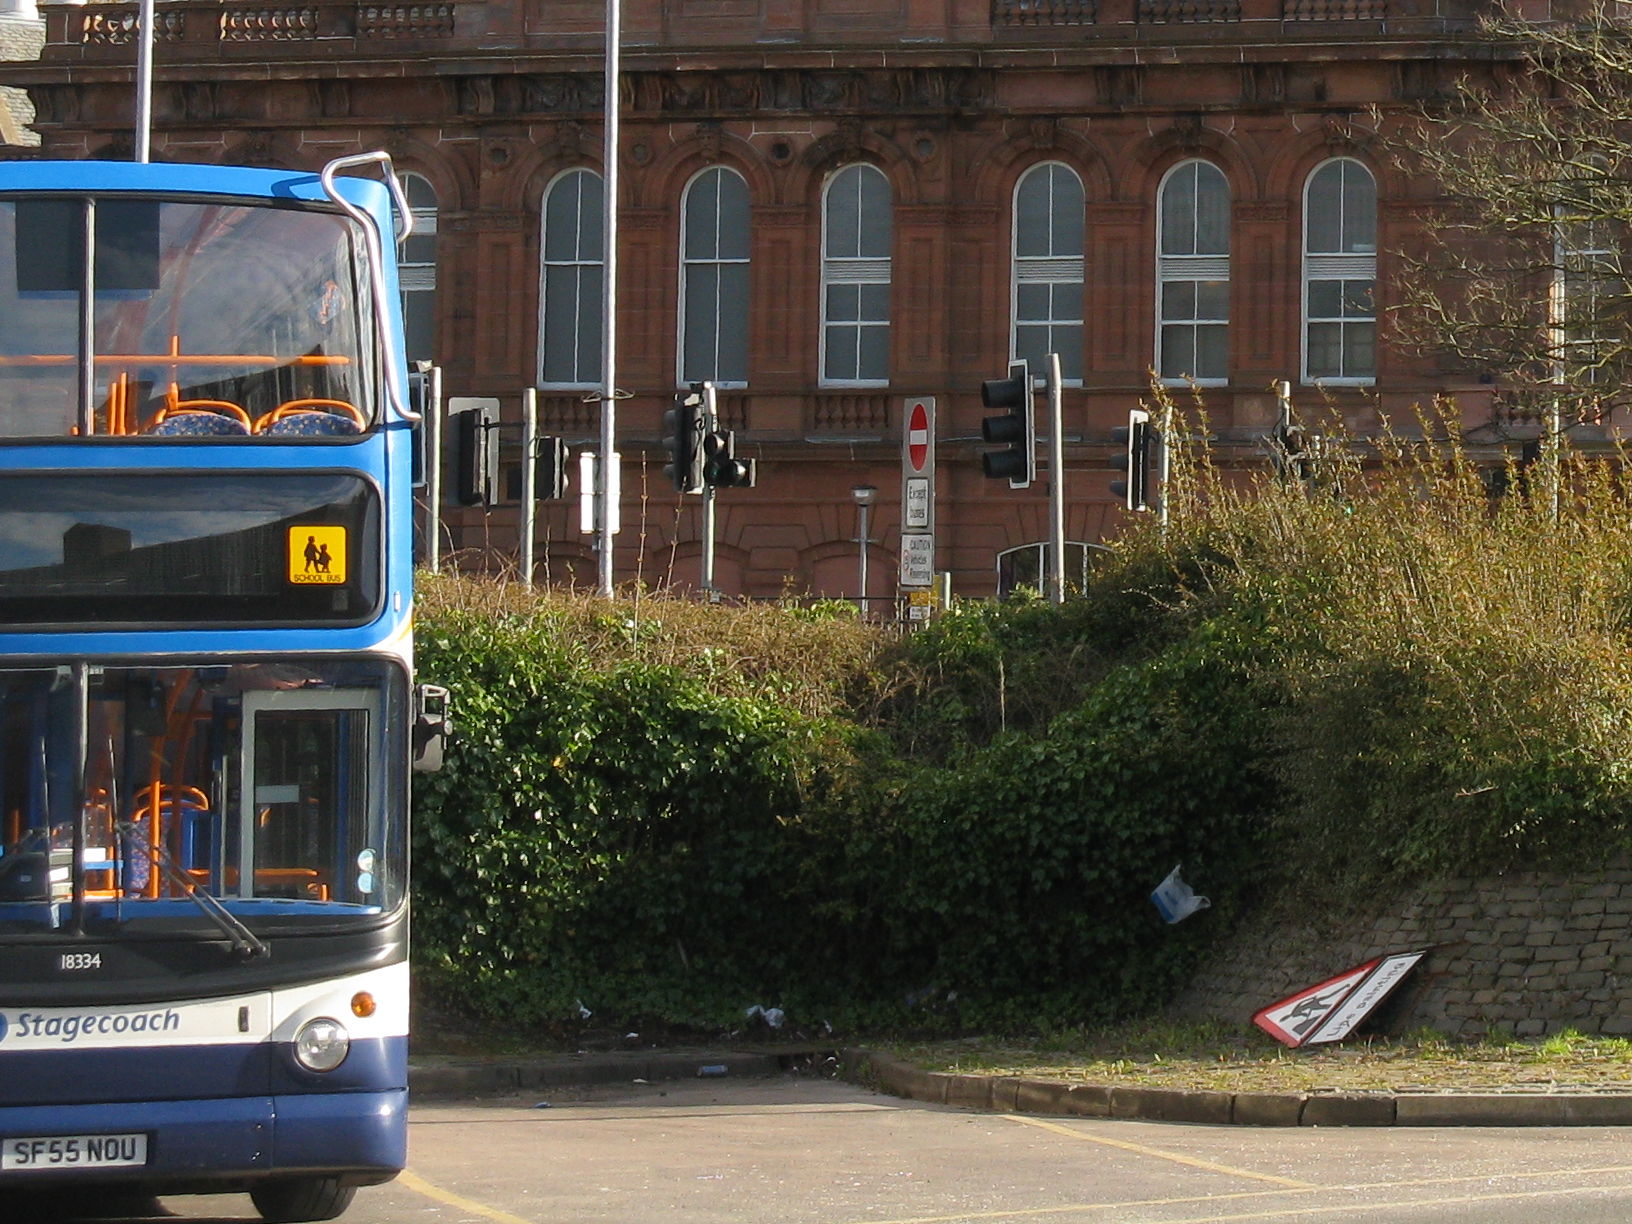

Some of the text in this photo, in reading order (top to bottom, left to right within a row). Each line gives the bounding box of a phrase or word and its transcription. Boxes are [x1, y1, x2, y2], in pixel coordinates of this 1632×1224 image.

[909, 485, 927, 501] Except
[294, 574, 341, 582] SCHOOL BUS
[61, 953, 102, 970] 18334
[16, 1008, 180, 1043] Stagecoach
[14, 1137, 136, 1164] SF55 NOU
